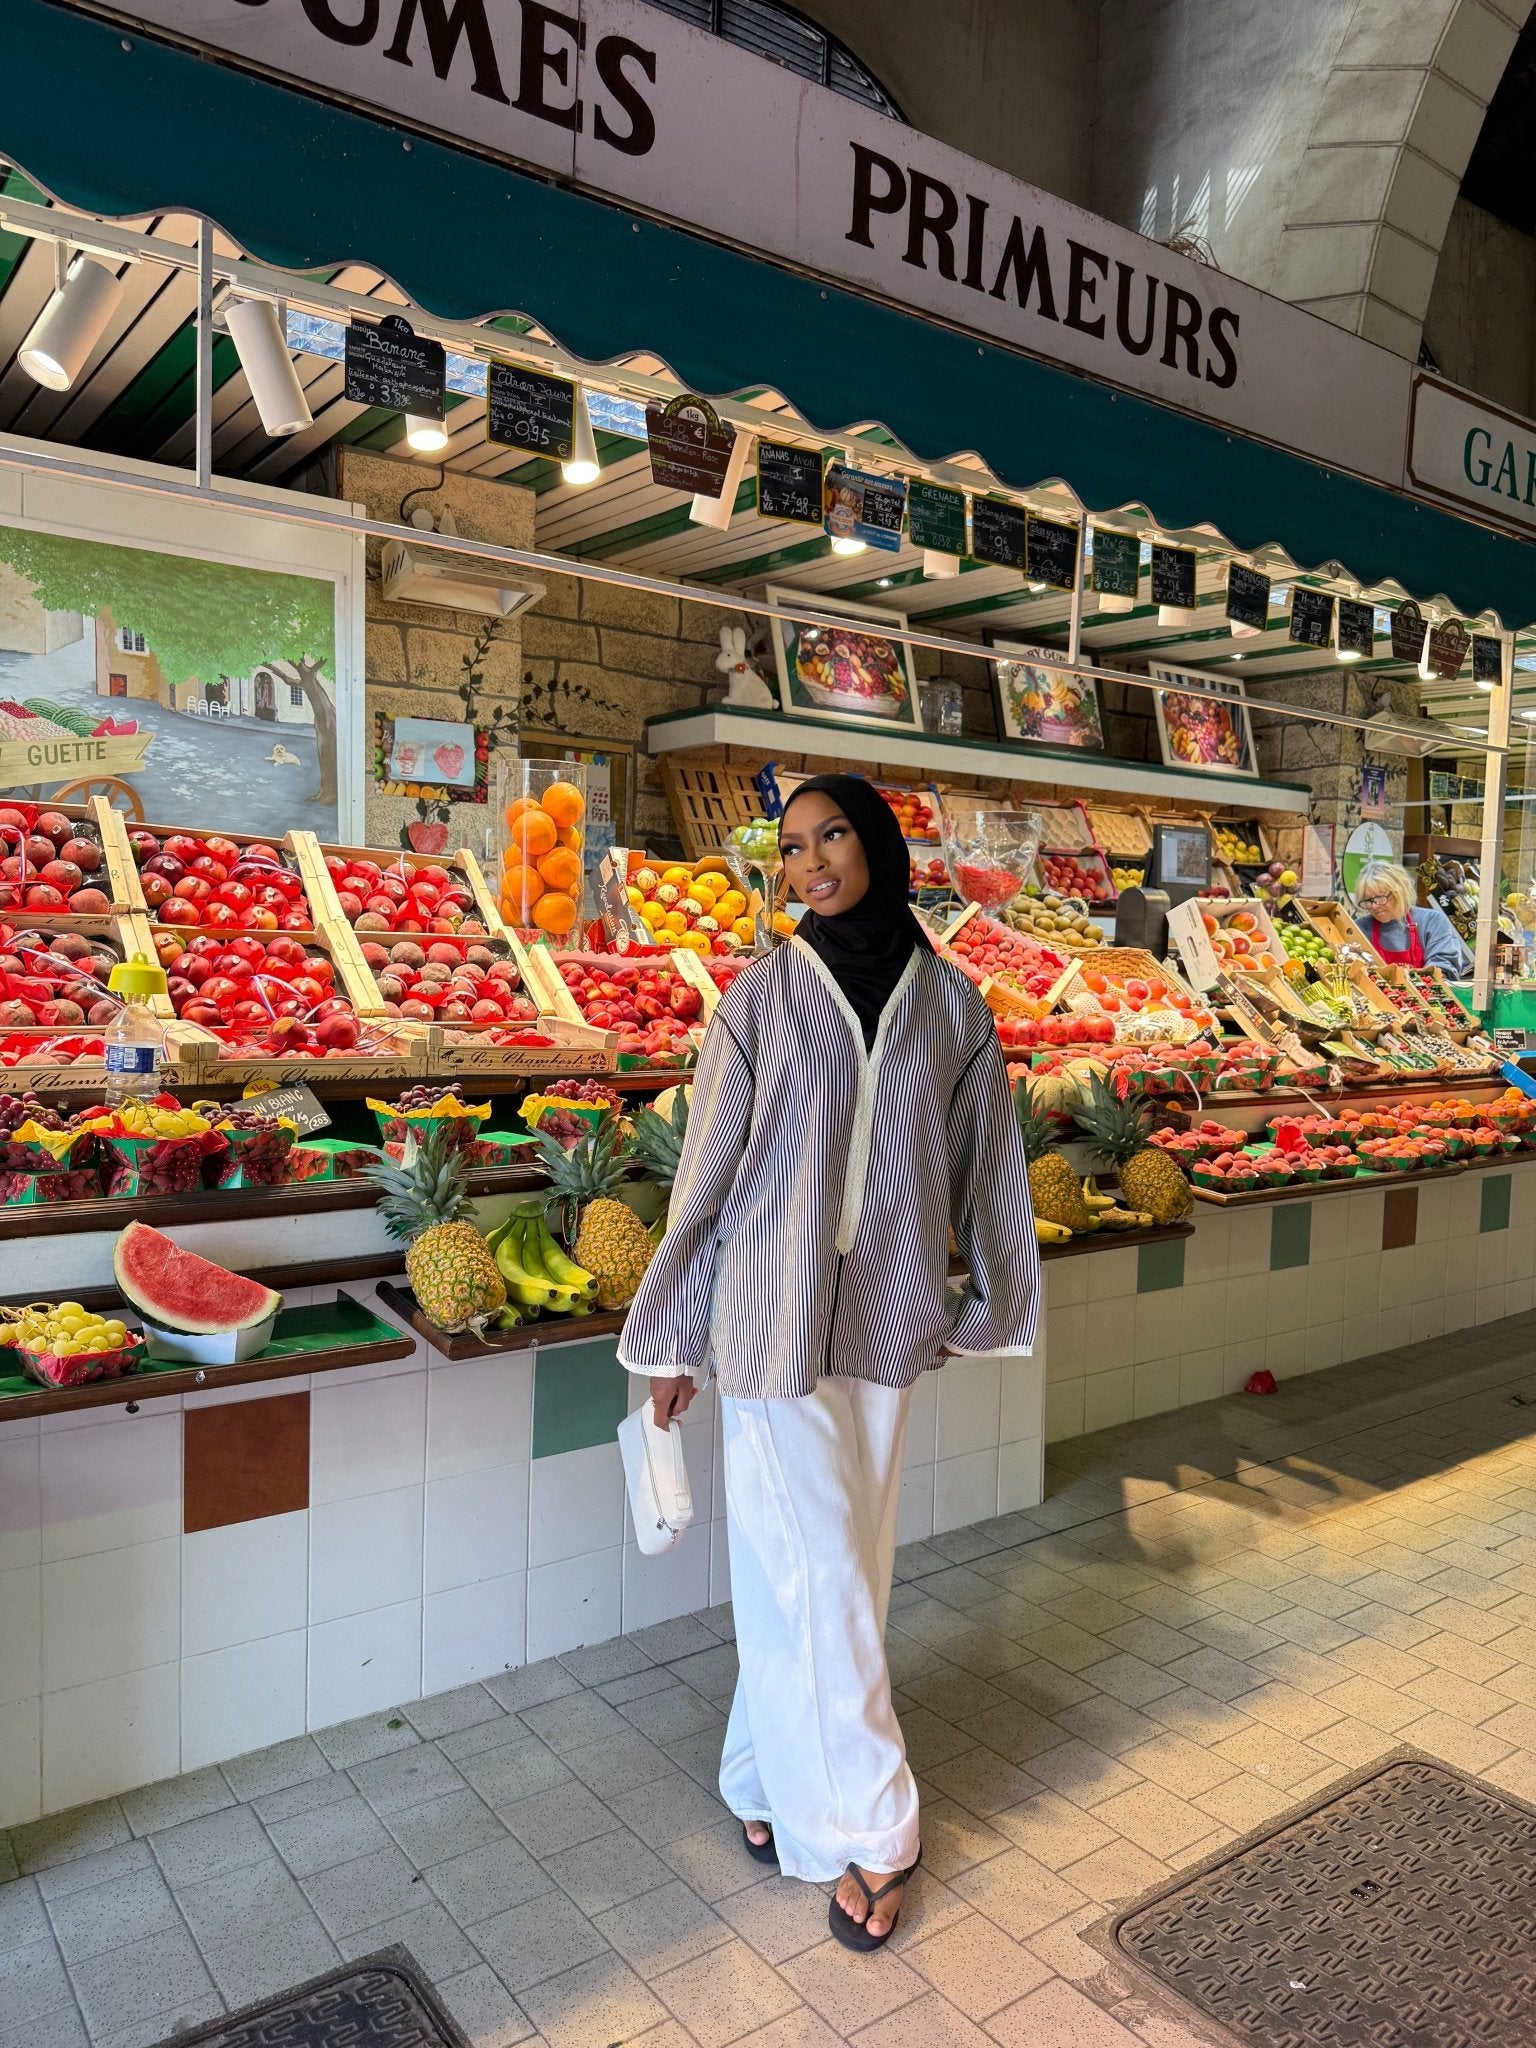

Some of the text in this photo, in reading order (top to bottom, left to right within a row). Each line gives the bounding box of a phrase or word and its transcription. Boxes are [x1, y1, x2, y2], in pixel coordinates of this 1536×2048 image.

[845, 142, 1240, 388] PRIMEURS
[361, 331, 427, 363] Banane
[686, 410, 700, 422] 1kg
[760, 448, 790, 461] ANANAS
[921, 487, 960, 505] GRENADE
[1237, 569, 1269, 590] MANGUE
[27, 740, 107, 766] GUETTE
[251, 1083, 273, 1094] 1kg
[267, 1089, 304, 1110] BLANC
[311, 1115, 329, 1127] 203
